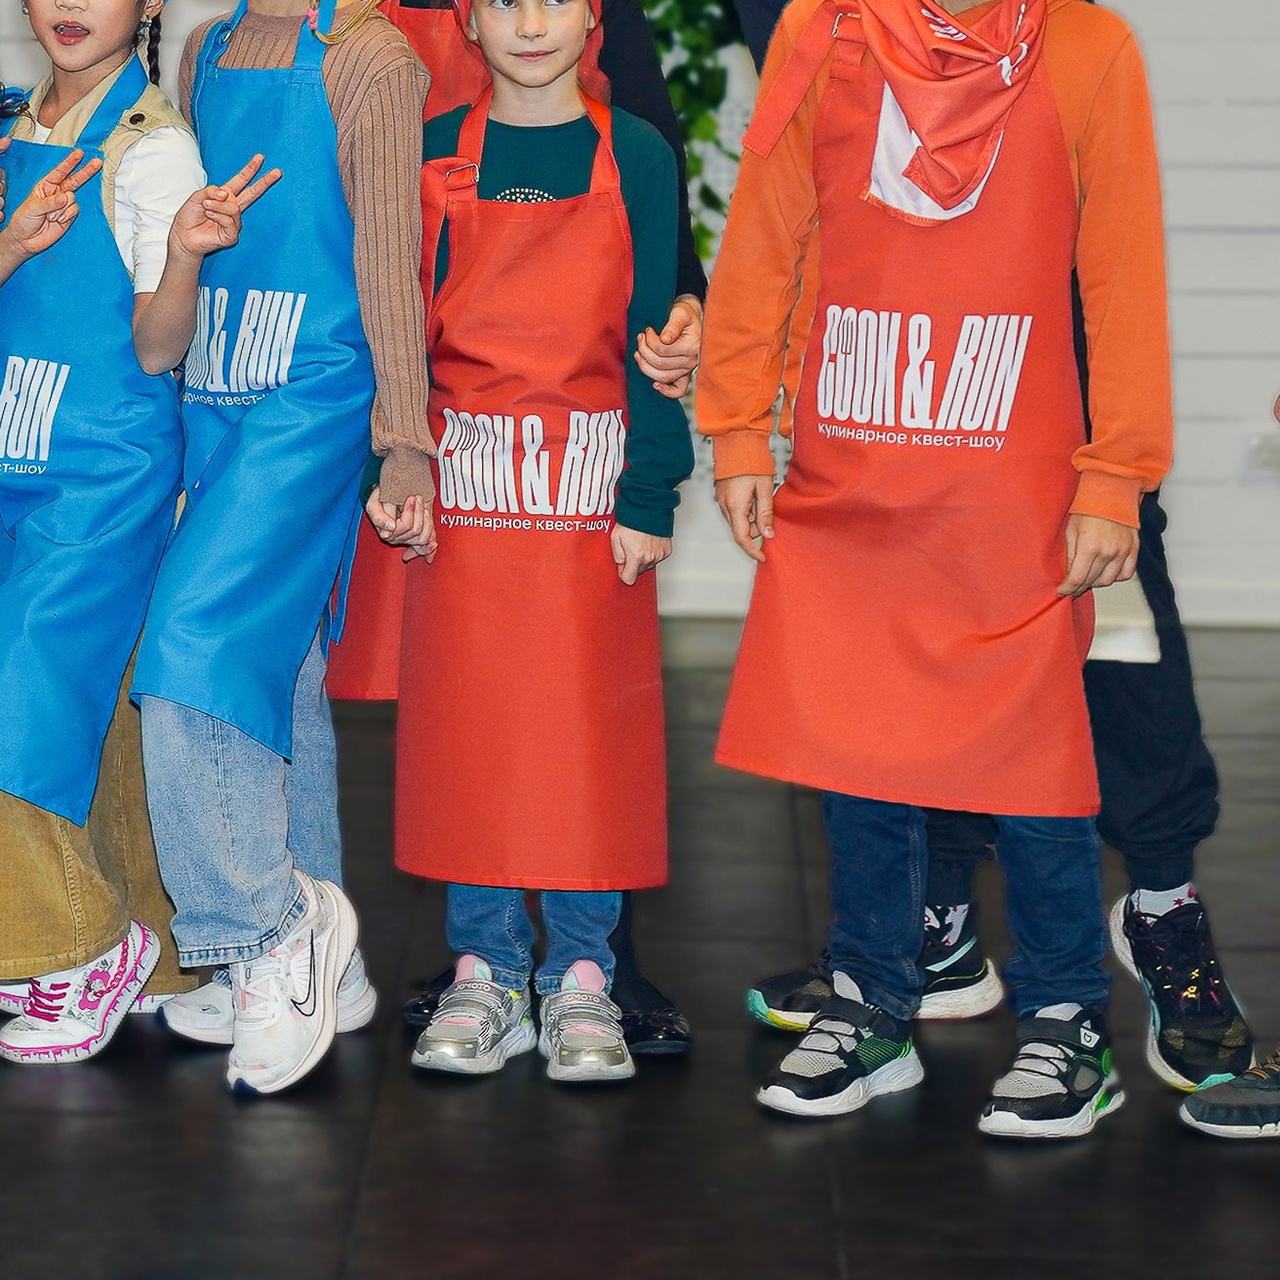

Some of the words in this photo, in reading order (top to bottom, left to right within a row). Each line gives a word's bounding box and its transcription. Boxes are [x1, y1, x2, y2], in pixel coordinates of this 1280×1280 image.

[206, 287, 229, 393] &
[229, 289, 308, 393] RUN
[817, 304, 902, 426] COOK
[900, 313, 936, 429] &
[935, 315, 1033, 432] RUN
[217, 393, 269, 406] квест-
[438, 408, 519, 514] COOK
[521, 414, 555, 515] &
[556, 409, 627, 516] RUN
[818, 422, 907, 444] кулинарное
[911, 432, 1005, 452] квест-шоу
[440, 513, 532, 531] кулинарное
[536, 519, 611, 533] квест-шоу
